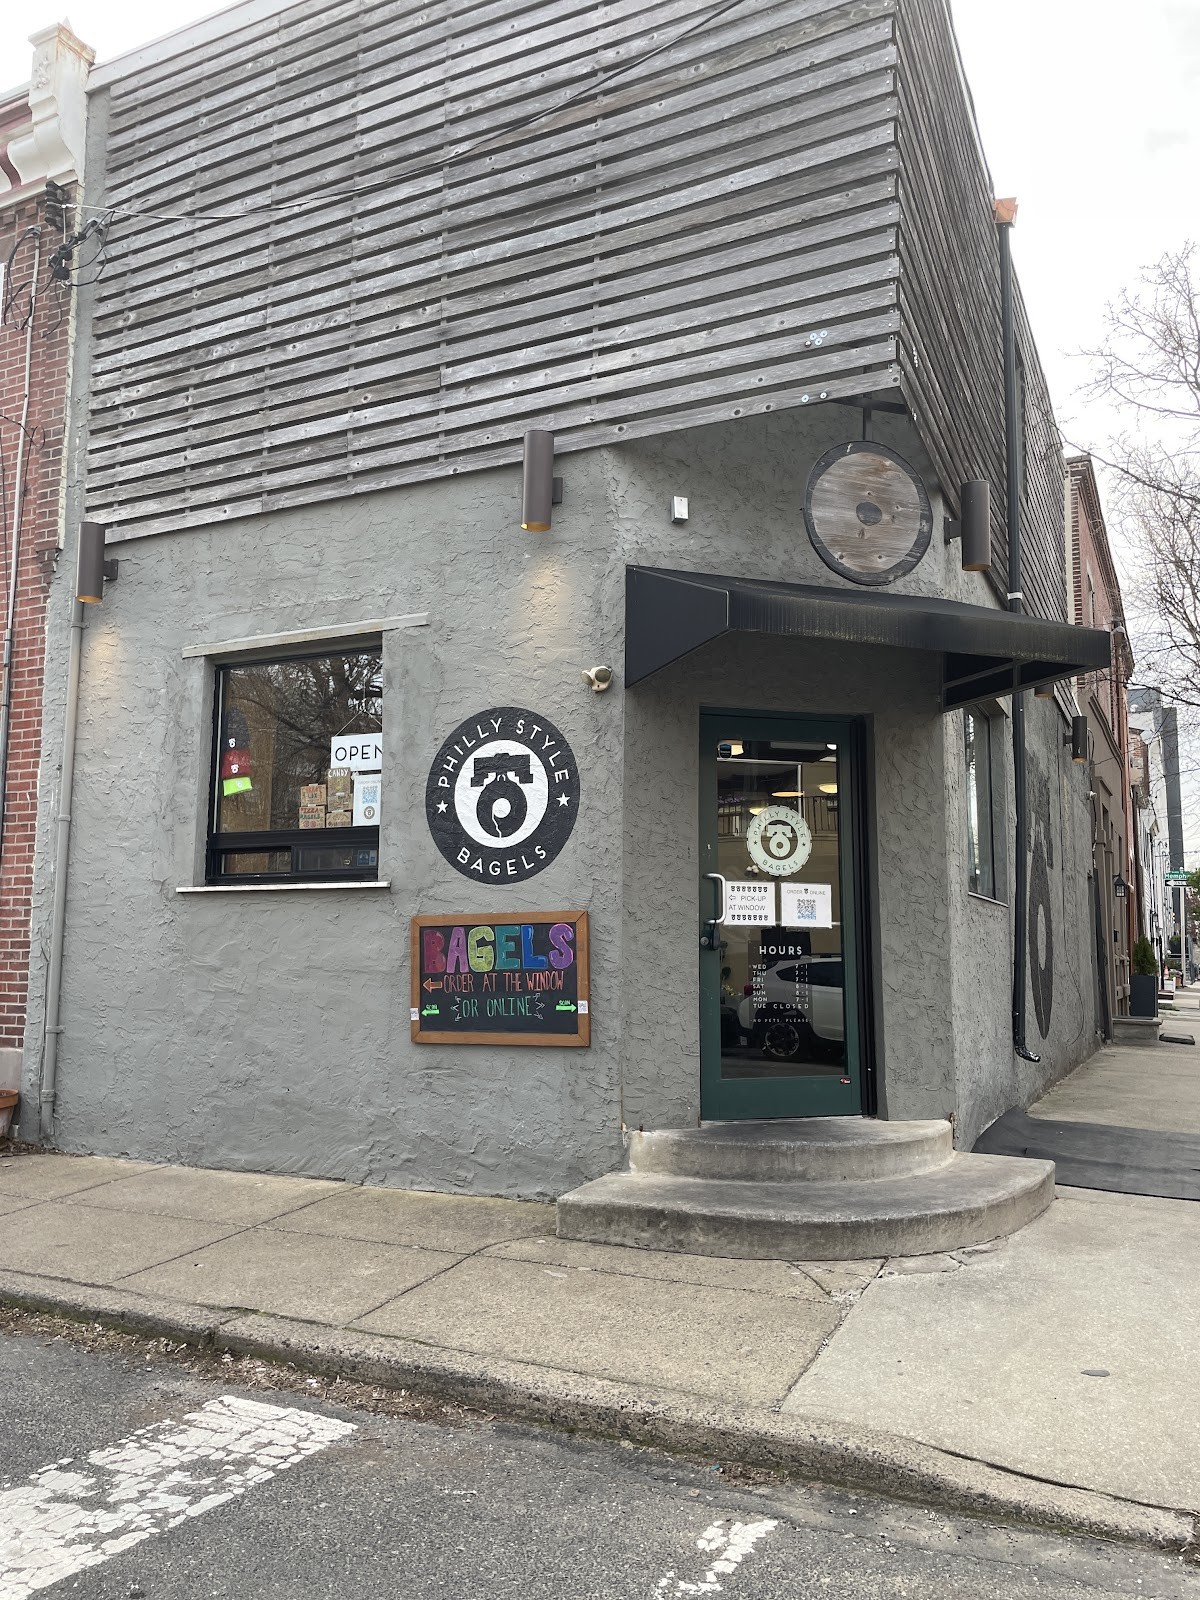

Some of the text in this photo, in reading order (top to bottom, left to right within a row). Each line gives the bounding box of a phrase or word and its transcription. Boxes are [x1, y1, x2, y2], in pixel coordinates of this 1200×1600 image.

[334, 744, 383, 761] OPEN
[437, 718, 570, 788] PHILLY STYLE
[328, 769, 349, 778] CANDY
[753, 810, 807, 839] PHILLY STYLE
[456, 845, 546, 876] BAGELS
[762, 858, 798, 871] BAGELS
[423, 923, 574, 973] BAGELS
[759, 945, 802, 955] HOURS
[443, 970, 564, 993] ORDER AT THE WINDOW
[462, 996, 532, 1017] OR ONLINE
